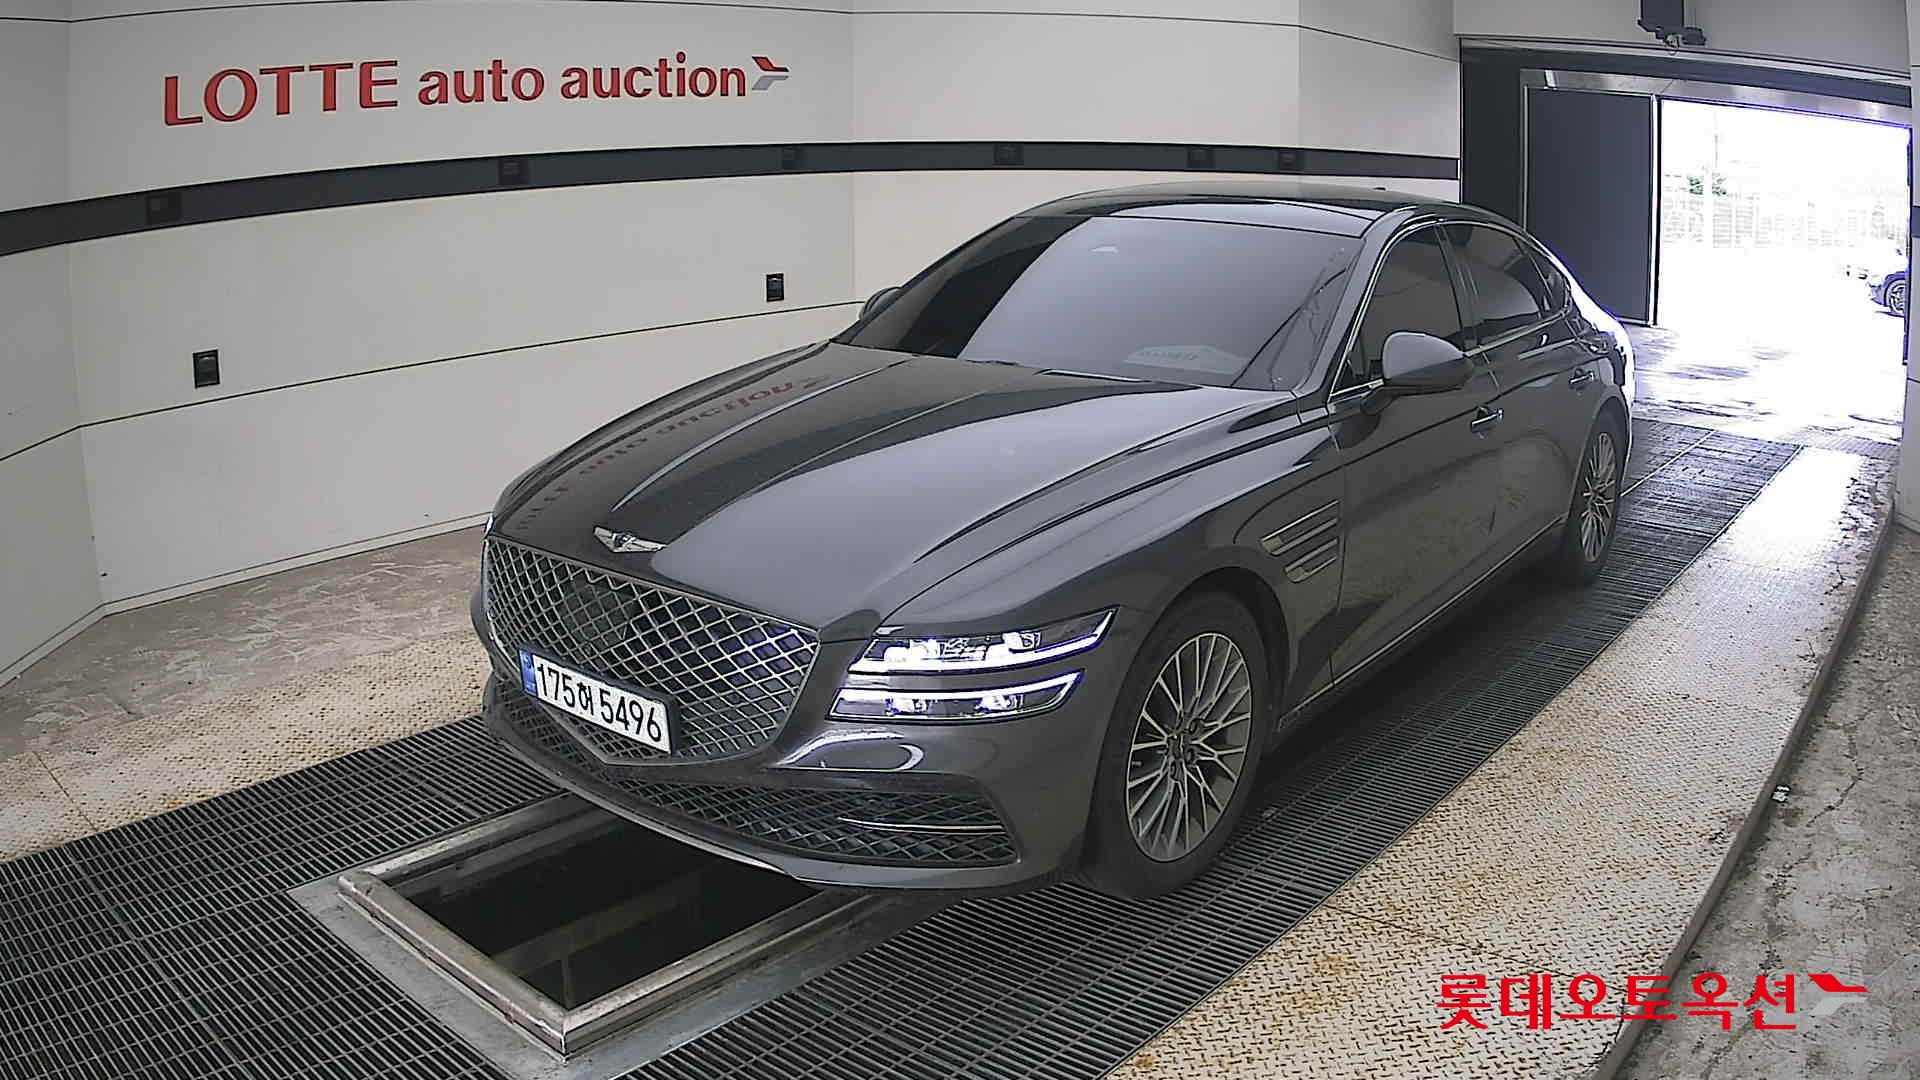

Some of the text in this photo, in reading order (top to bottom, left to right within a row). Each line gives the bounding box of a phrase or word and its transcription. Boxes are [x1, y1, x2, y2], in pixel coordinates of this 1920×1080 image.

[164, 51, 747, 126] LOTTE auto auction
[599, 688, 662, 743] 5496
